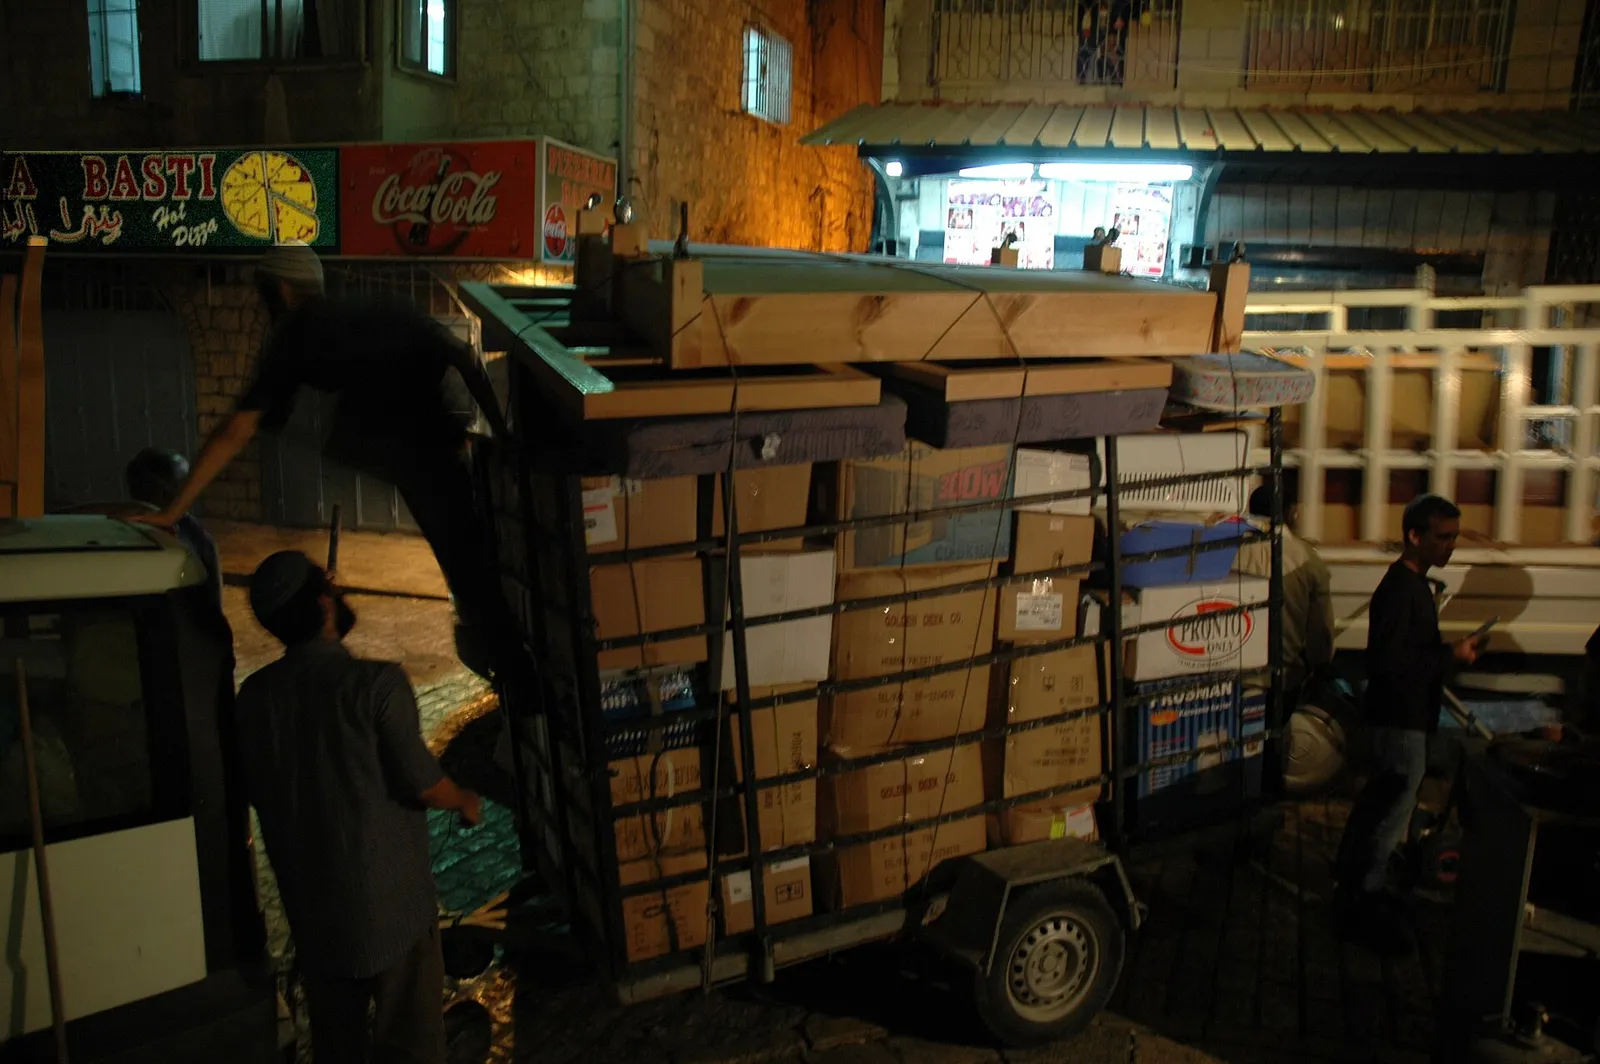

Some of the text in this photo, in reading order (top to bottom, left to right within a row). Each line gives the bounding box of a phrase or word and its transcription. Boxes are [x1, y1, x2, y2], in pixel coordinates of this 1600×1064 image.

[81, 153, 216, 200] BASTI
[152, 200, 186, 231] Hot
[1181, 612, 1241, 643] PRONTO
[1207, 641, 1234, 654] ONLY
